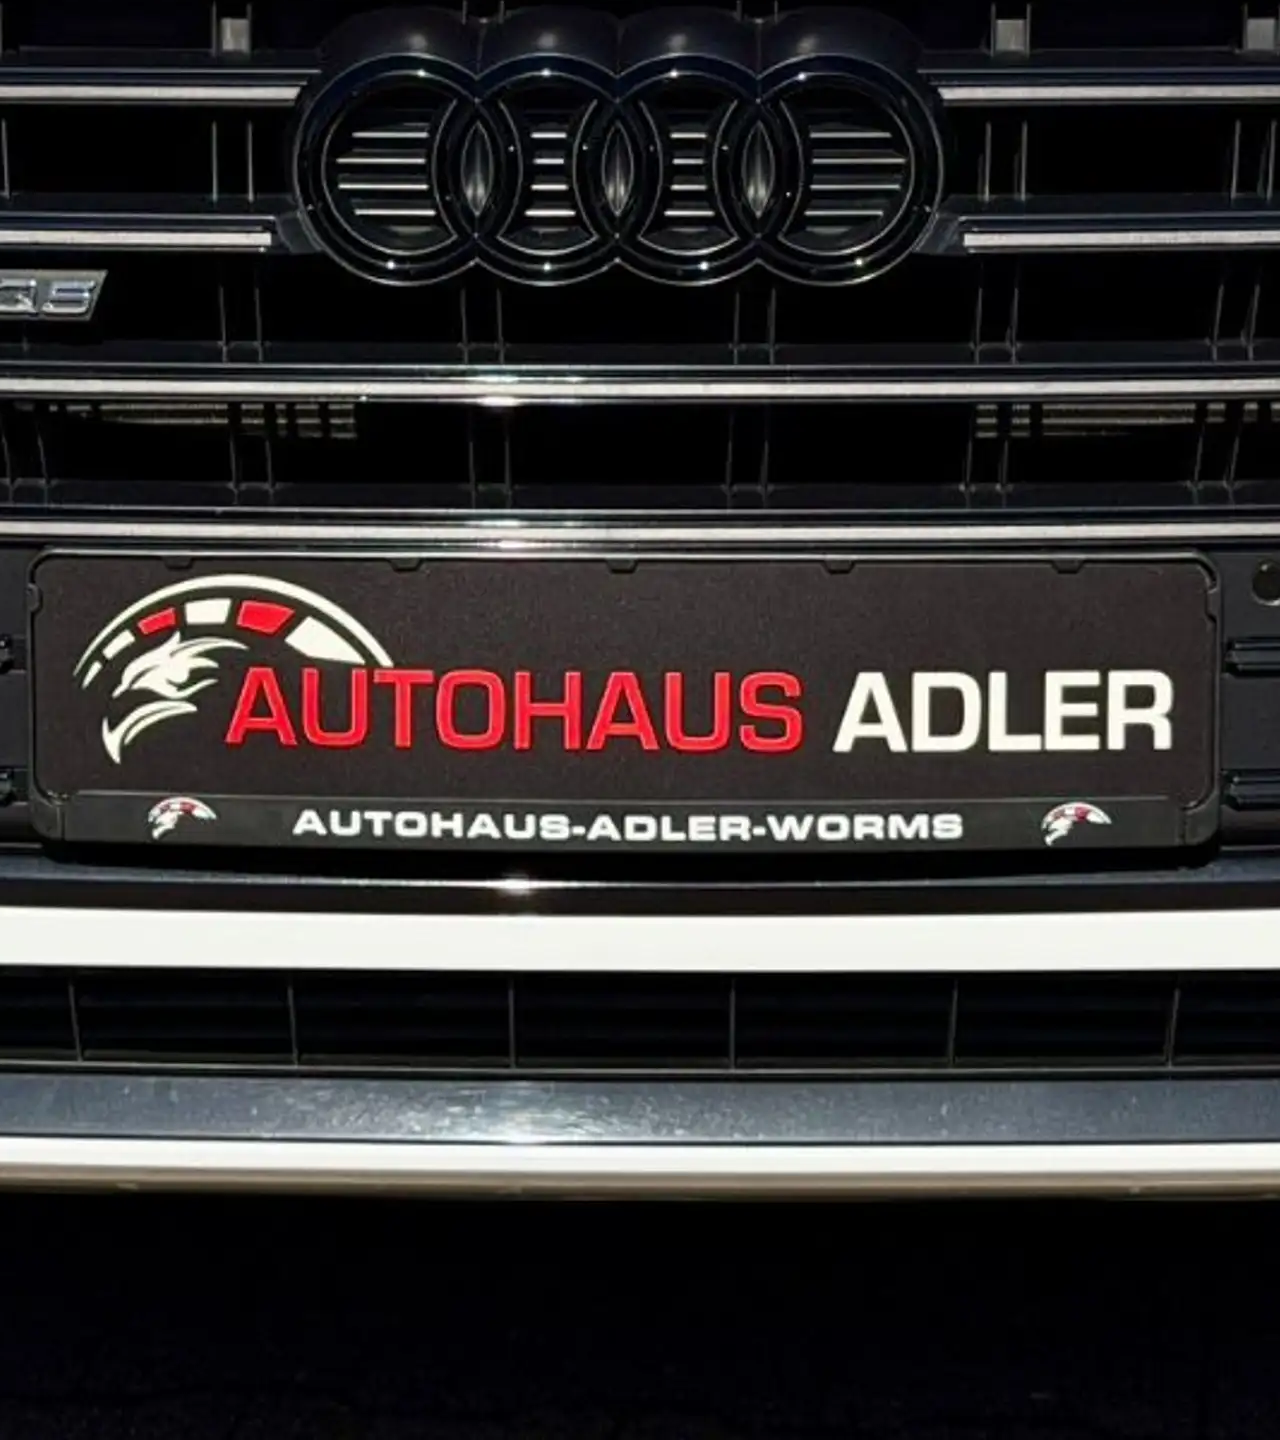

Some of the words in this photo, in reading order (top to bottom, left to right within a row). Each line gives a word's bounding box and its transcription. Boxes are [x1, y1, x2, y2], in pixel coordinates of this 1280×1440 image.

[224, 666, 804, 753] AUTOHAUS
[832, 669, 1175, 753] ADLER
[292, 809, 964, 842] AUTOHAUS-ADLER-WORMS
